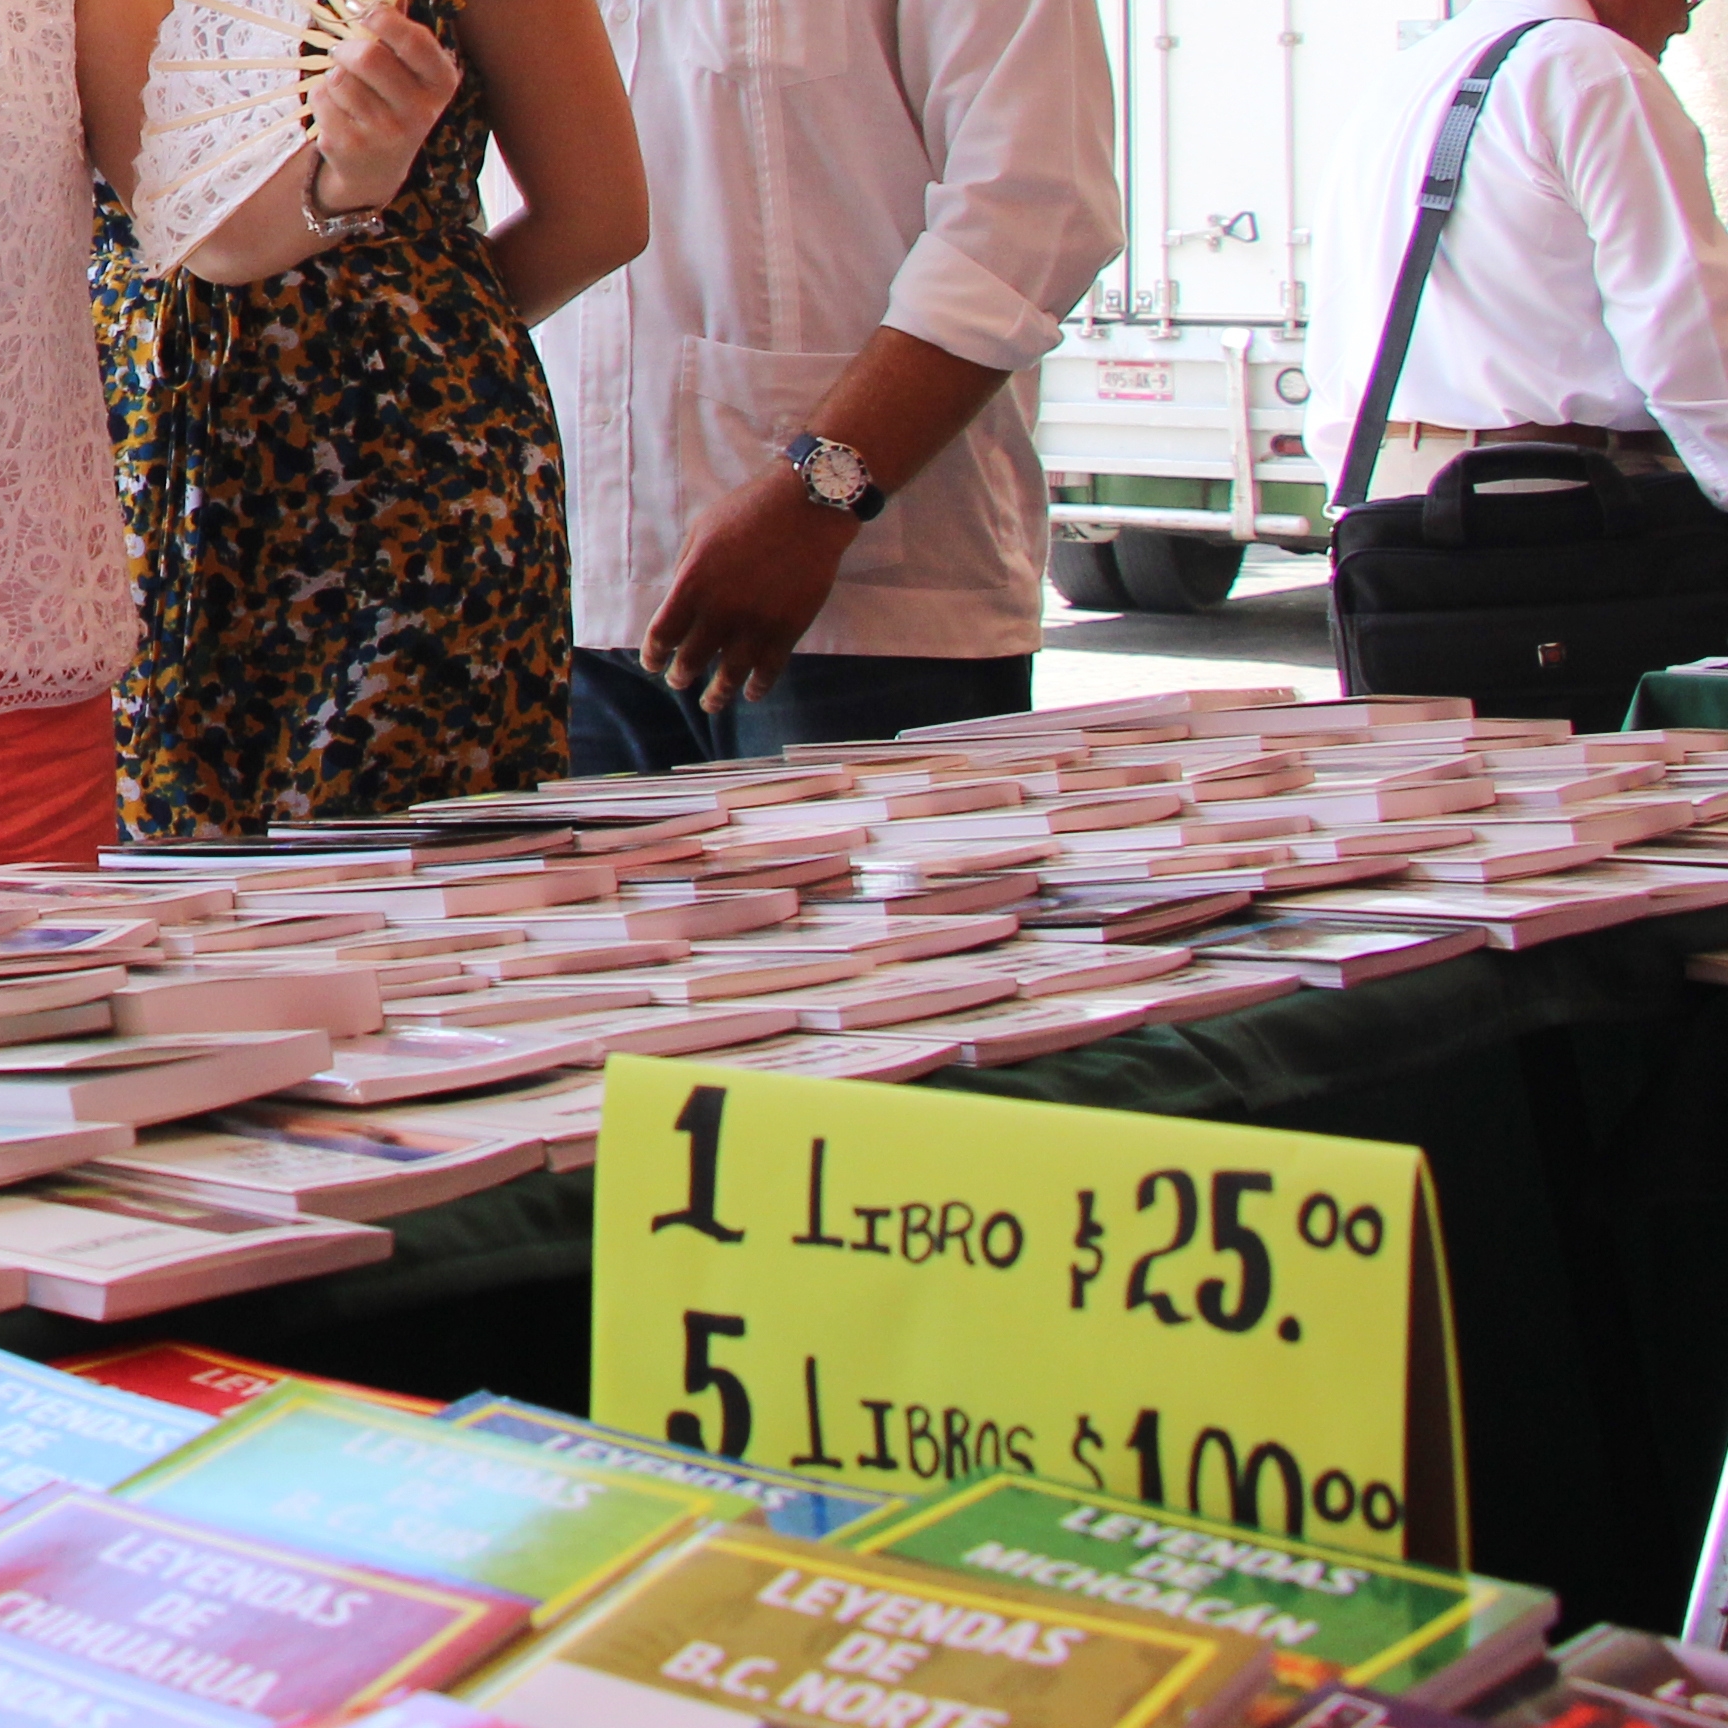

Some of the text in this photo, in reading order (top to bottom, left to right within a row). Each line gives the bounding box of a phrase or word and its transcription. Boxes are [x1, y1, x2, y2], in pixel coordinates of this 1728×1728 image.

[651, 1085, 745, 1243] 1
[666, 1310, 752, 1462] 5
[342, 1429, 608, 1511] LEYENDAS
[98, 1531, 374, 1630] LEYENDAS
[1059, 1505, 1373, 1596] LEYENDAS
[1129, 1551, 1227, 1592] DE
[135, 1590, 228, 1639] DE
[756, 1568, 1088, 1667] LEYENDAS
[824, 1630, 932, 1683] DE
[660, 1638, 780, 1702] B.C.
